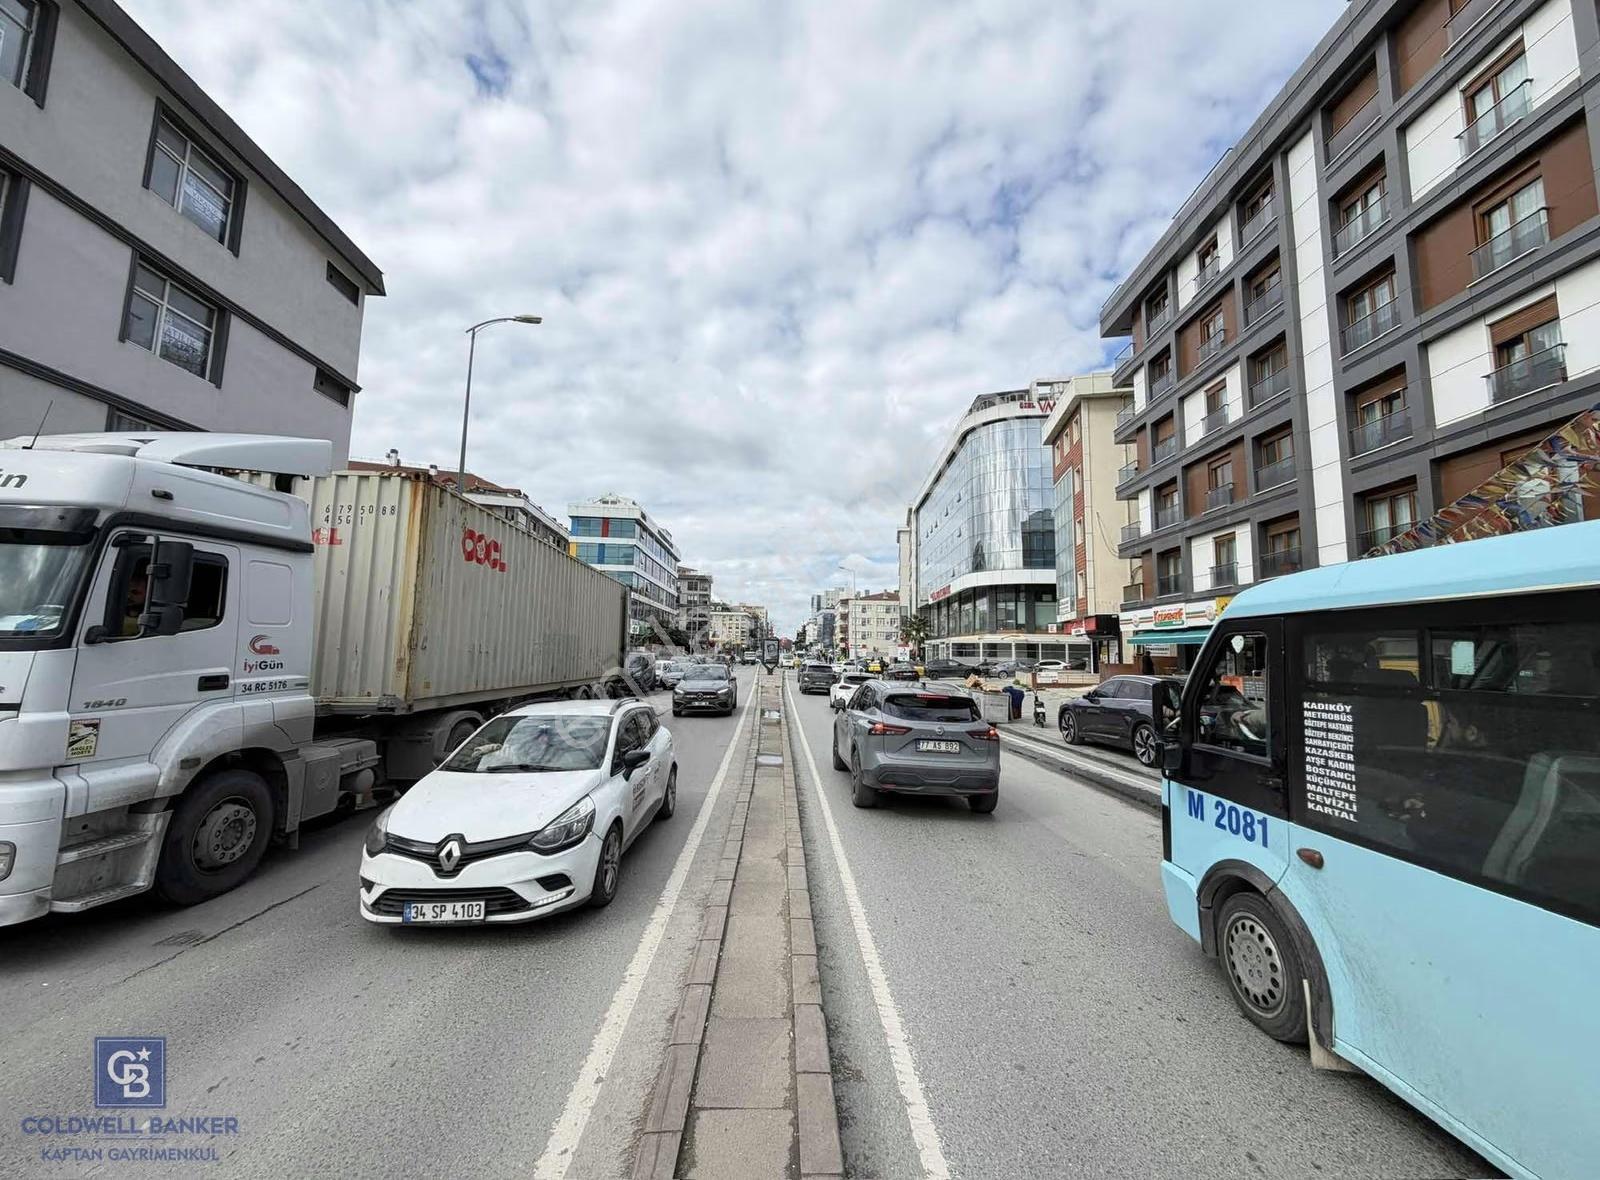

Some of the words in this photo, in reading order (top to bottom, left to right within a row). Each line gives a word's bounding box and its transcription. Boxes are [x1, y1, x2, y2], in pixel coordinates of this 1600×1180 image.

[241, 684, 253, 692] 34
[254, 682, 267, 691] RC
[268, 680, 288, 690] 5176
[83, 698, 128, 709] 1840
[1303, 701, 1352, 713] KADIKÖY
[1303, 710, 1353, 722] METROBÜS
[1305, 755, 1326, 766] AYŞE
[1328, 759, 1355, 771] KADIN
[1305, 764, 1356, 781] BOSTANCI
[1306, 774, 1356, 791] KÜÇÜKYALI
[1306, 783, 1357, 802] MALTEPE
[1307, 792, 1357, 812] CEVİZLİ
[1188, 790, 1204, 822] M
[1214, 800, 1268, 848] 2081
[1307, 801, 1358, 822] KARTAL
[412, 905, 425, 919] 34
[432, 904, 446, 919] SP
[452, 903, 482, 918] 4103
